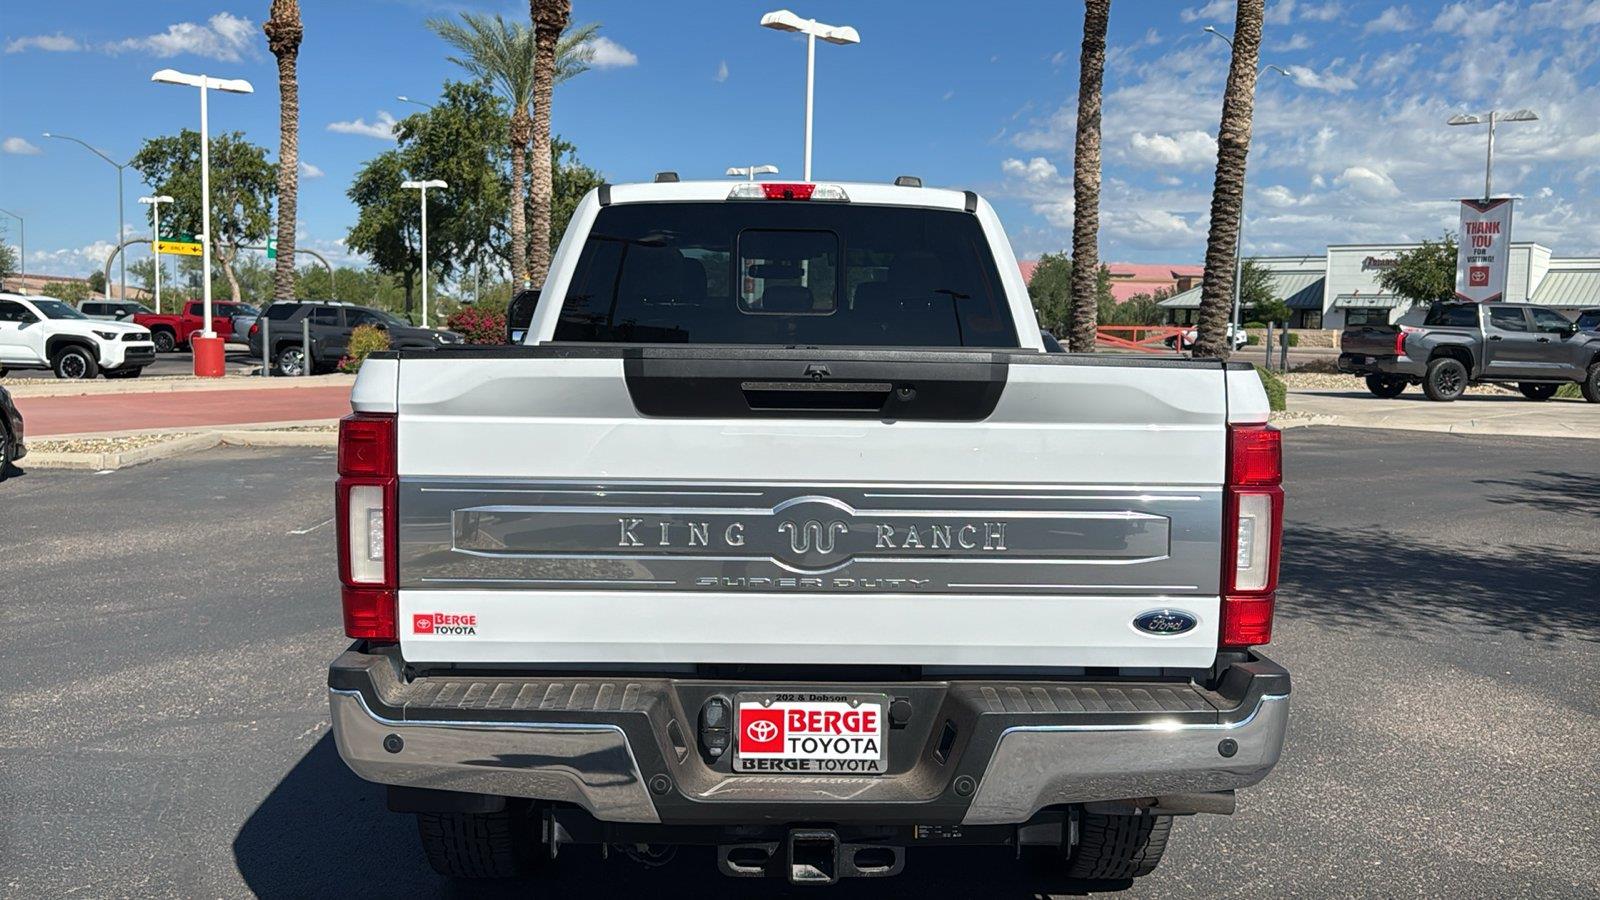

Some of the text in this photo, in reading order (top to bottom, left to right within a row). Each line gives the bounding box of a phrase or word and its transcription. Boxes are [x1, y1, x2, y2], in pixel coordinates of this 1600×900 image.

[1466, 221, 1501, 234] THANK
[1471, 235, 1492, 248] YOU
[618, 518, 1007, 550] KING RANCH
[696, 576, 930, 588] SUPER DUTY
[434, 613, 476, 626] BERGE
[1148, 615, 1184, 630] Ford
[434, 626, 476, 635] TOYOTA
[809, 694, 847, 702] Dobson
[788, 709, 877, 735] BERGE
[788, 737, 879, 754] TOYOTA
[742, 758, 879, 771] BERGE TOYOTA
